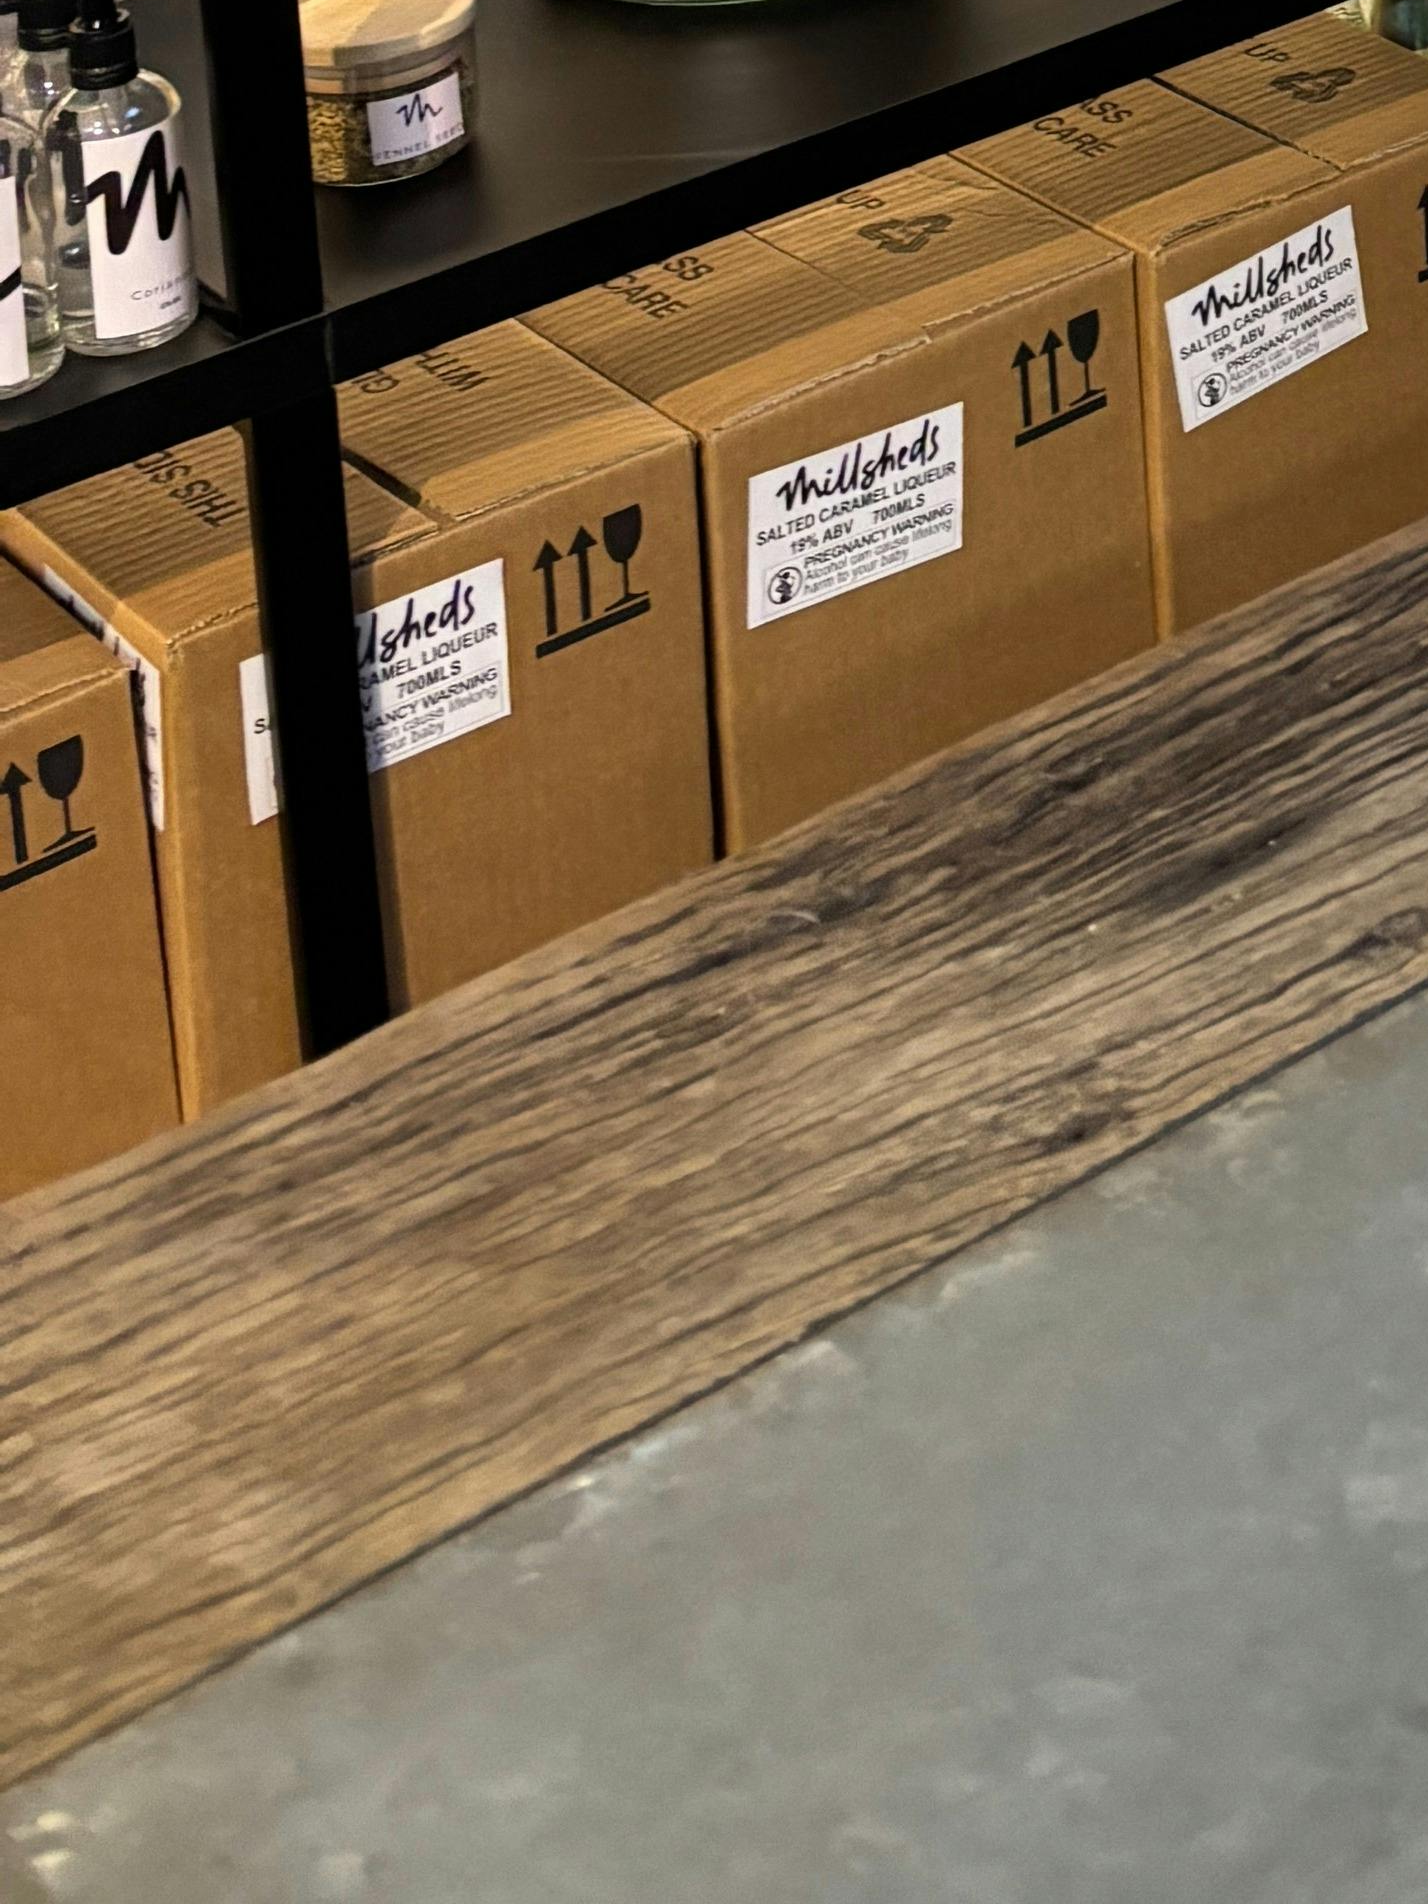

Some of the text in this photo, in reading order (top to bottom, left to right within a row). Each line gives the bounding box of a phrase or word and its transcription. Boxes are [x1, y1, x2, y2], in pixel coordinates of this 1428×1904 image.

[1033, 117, 1117, 158] CARE
[836, 190, 885, 210] UP
[602, 274, 688, 319] CARE
[1191, 225, 1335, 327] Millsheds
[1179, 257, 1353, 361] SALTED CARAMEL LIQUEUR
[1226, 294, 1356, 373] PREGNANCY WARNING
[1239, 325, 1266, 348] ABV
[1281, 290, 1329, 324] 700MLS
[776, 419, 939, 511] Millsheds
[169, 479, 247, 528] THIS
[756, 461, 956, 546] SALTED CARAMEL LIQUEUR
[823, 519, 855, 543] ABV
[872, 493, 926, 524] 700MLS
[803, 504, 954, 569] PREGNANCY WARNING
[806, 555, 849, 580] Alcohol
[852, 559, 879, 581] your
[881, 548, 909, 570] baby
[421, 622, 498, 667] LIQUEUR
[397, 660, 462, 699] 700MLS
[421, 668, 498, 709] WARNING
